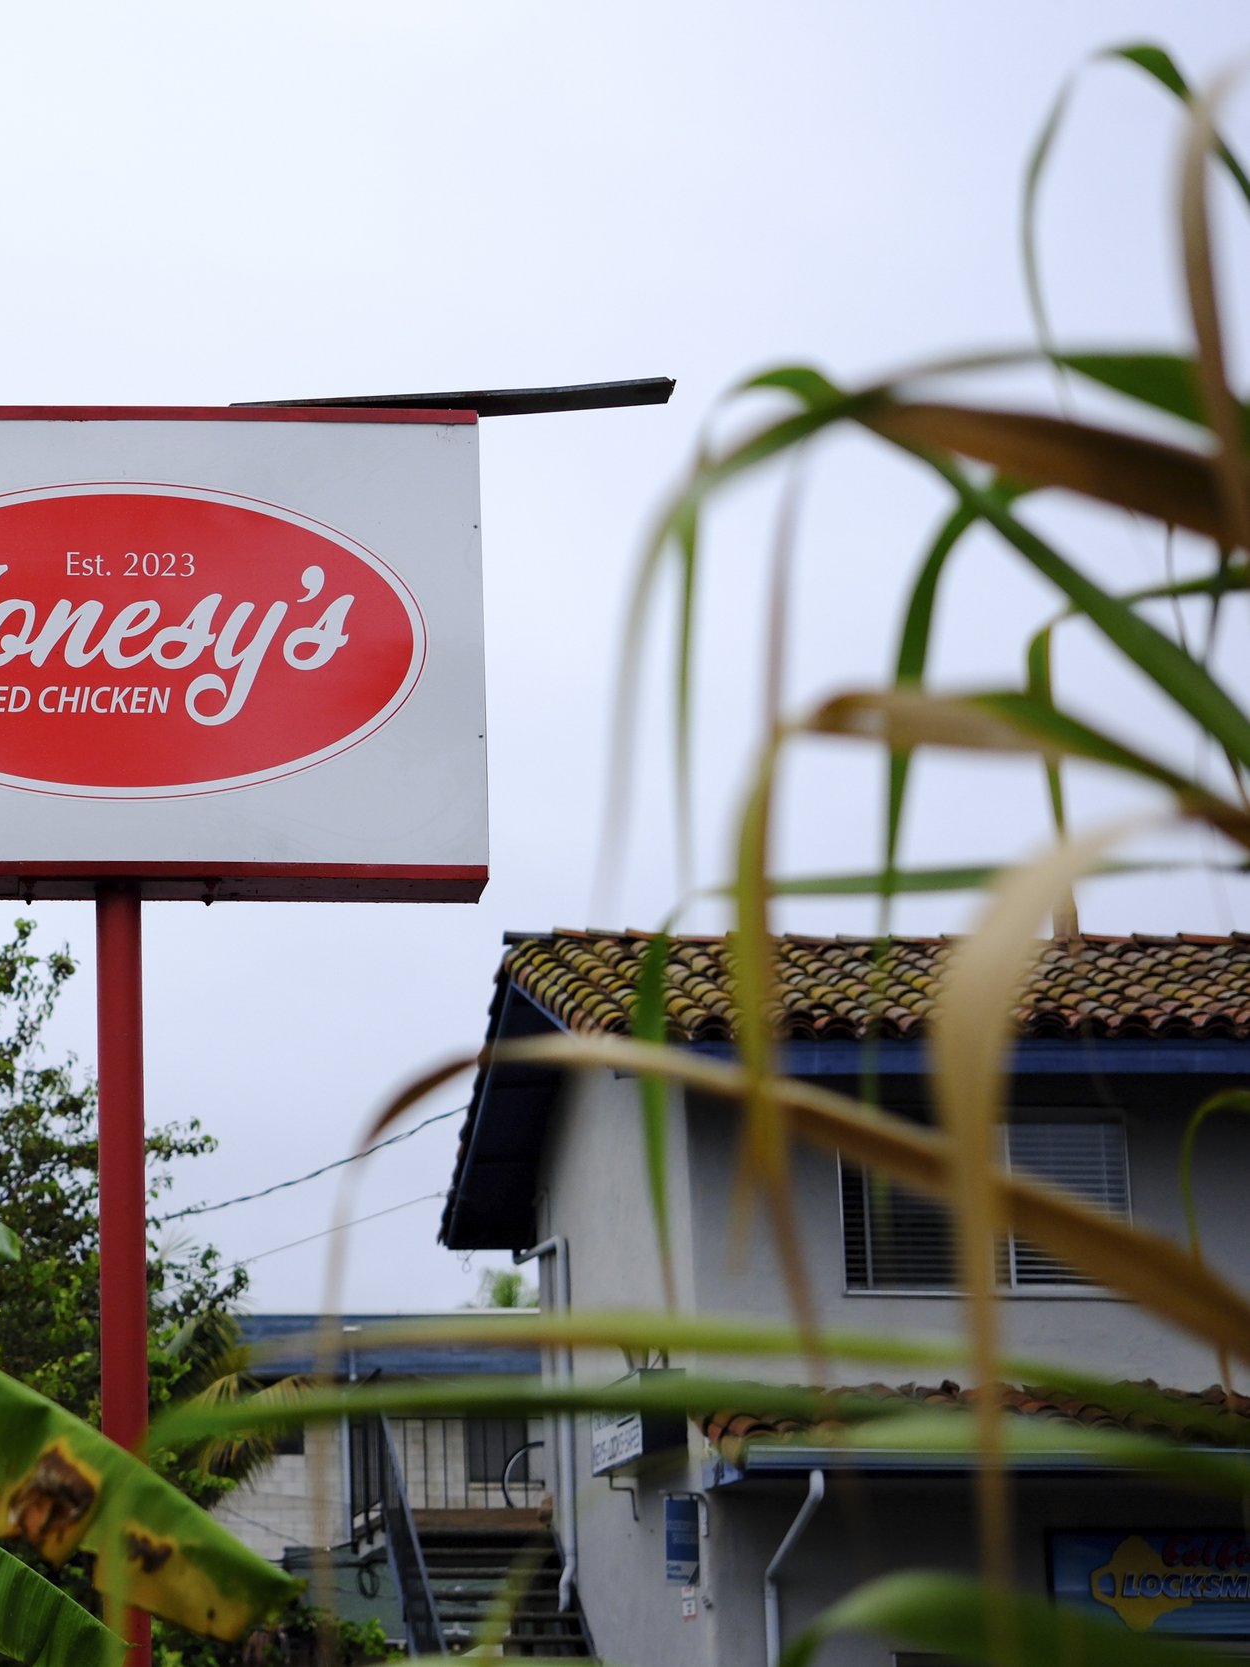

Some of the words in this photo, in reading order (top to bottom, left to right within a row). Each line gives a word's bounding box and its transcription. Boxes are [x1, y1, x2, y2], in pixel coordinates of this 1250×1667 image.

[65, 551, 111, 577] Est.
[123, 551, 196, 577] 2023
[38, 685, 171, 714] CHICKEN
